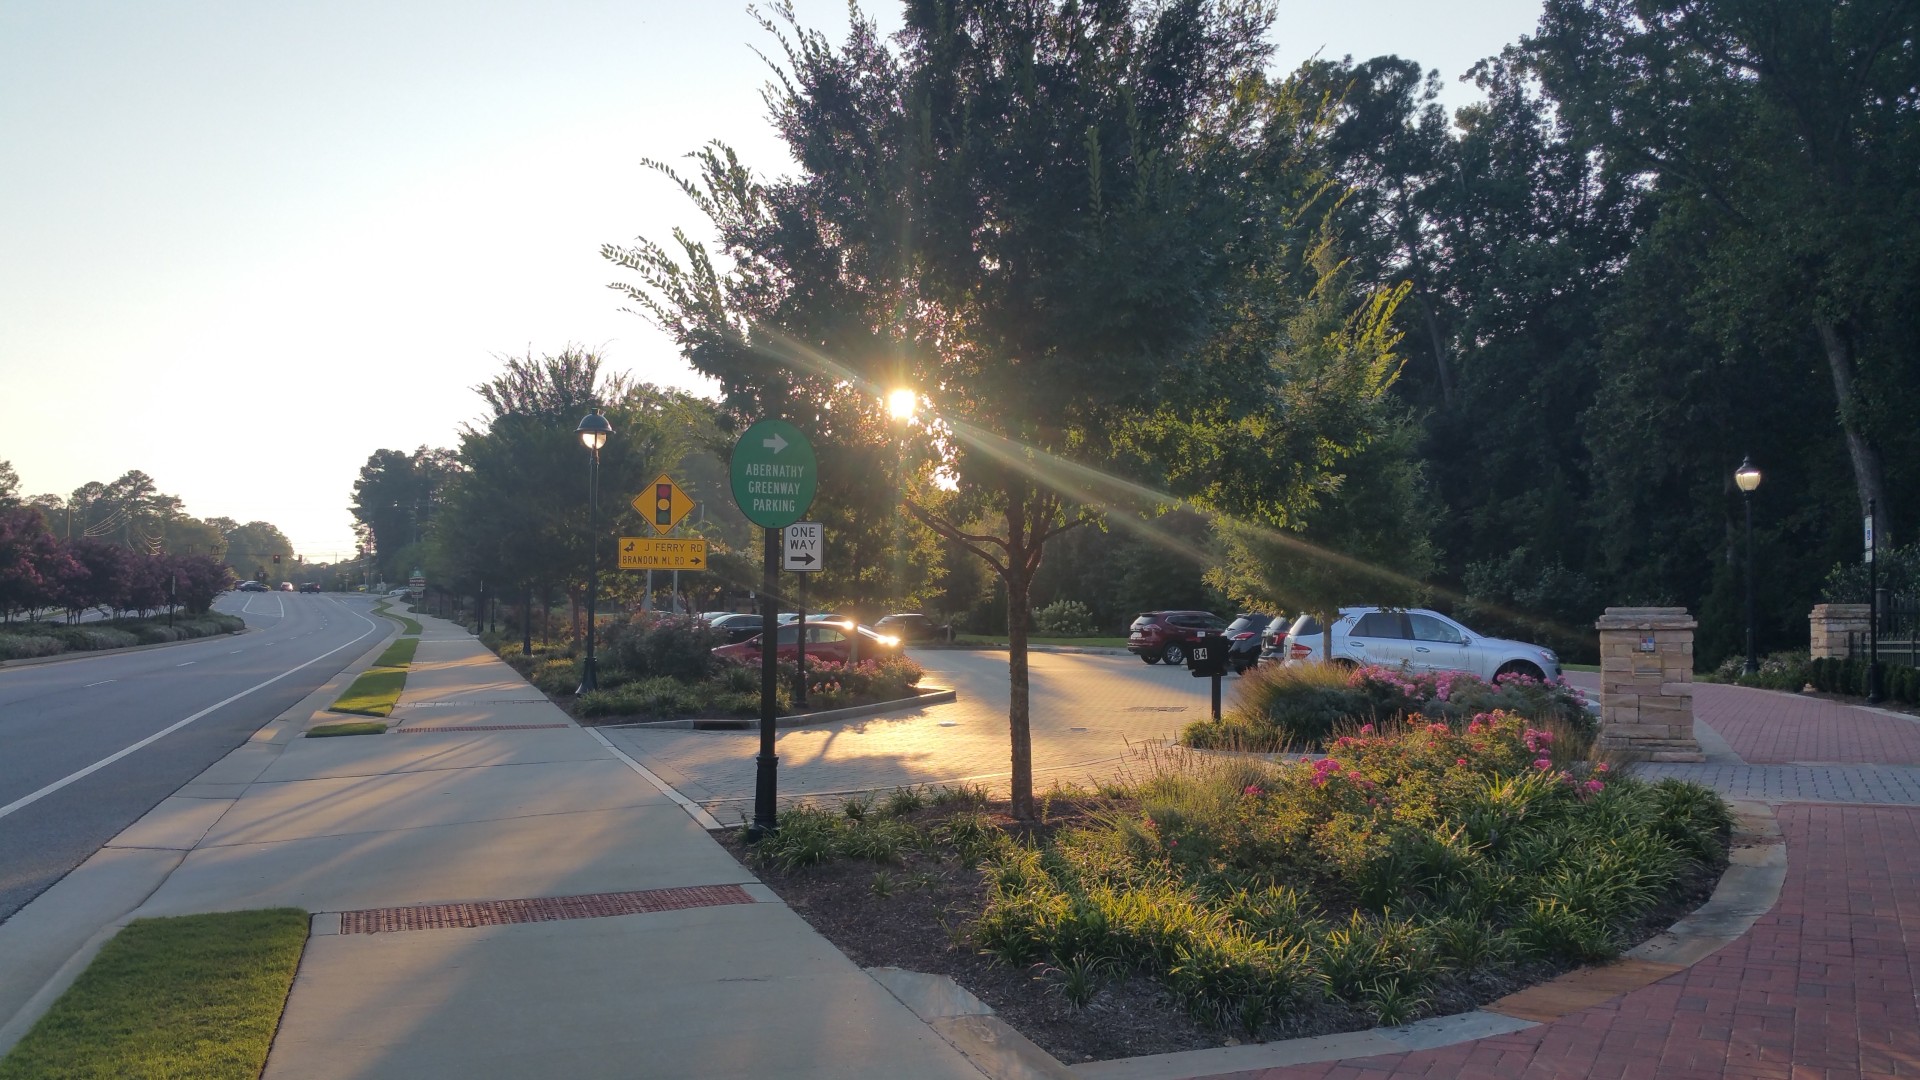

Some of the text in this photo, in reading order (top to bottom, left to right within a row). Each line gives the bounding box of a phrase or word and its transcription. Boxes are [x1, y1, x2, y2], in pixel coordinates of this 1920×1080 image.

[745, 463, 804, 478] ABERNATHY
[748, 481, 800, 495] GREENWAY
[753, 498, 795, 512] PARKING
[791, 527, 815, 538] ONE
[645, 542, 703, 552] J FERRY RD
[790, 540, 816, 550] WAY
[622, 555, 684, 565] BRANDON ML RD
[1195, 648, 1207, 660] 84
